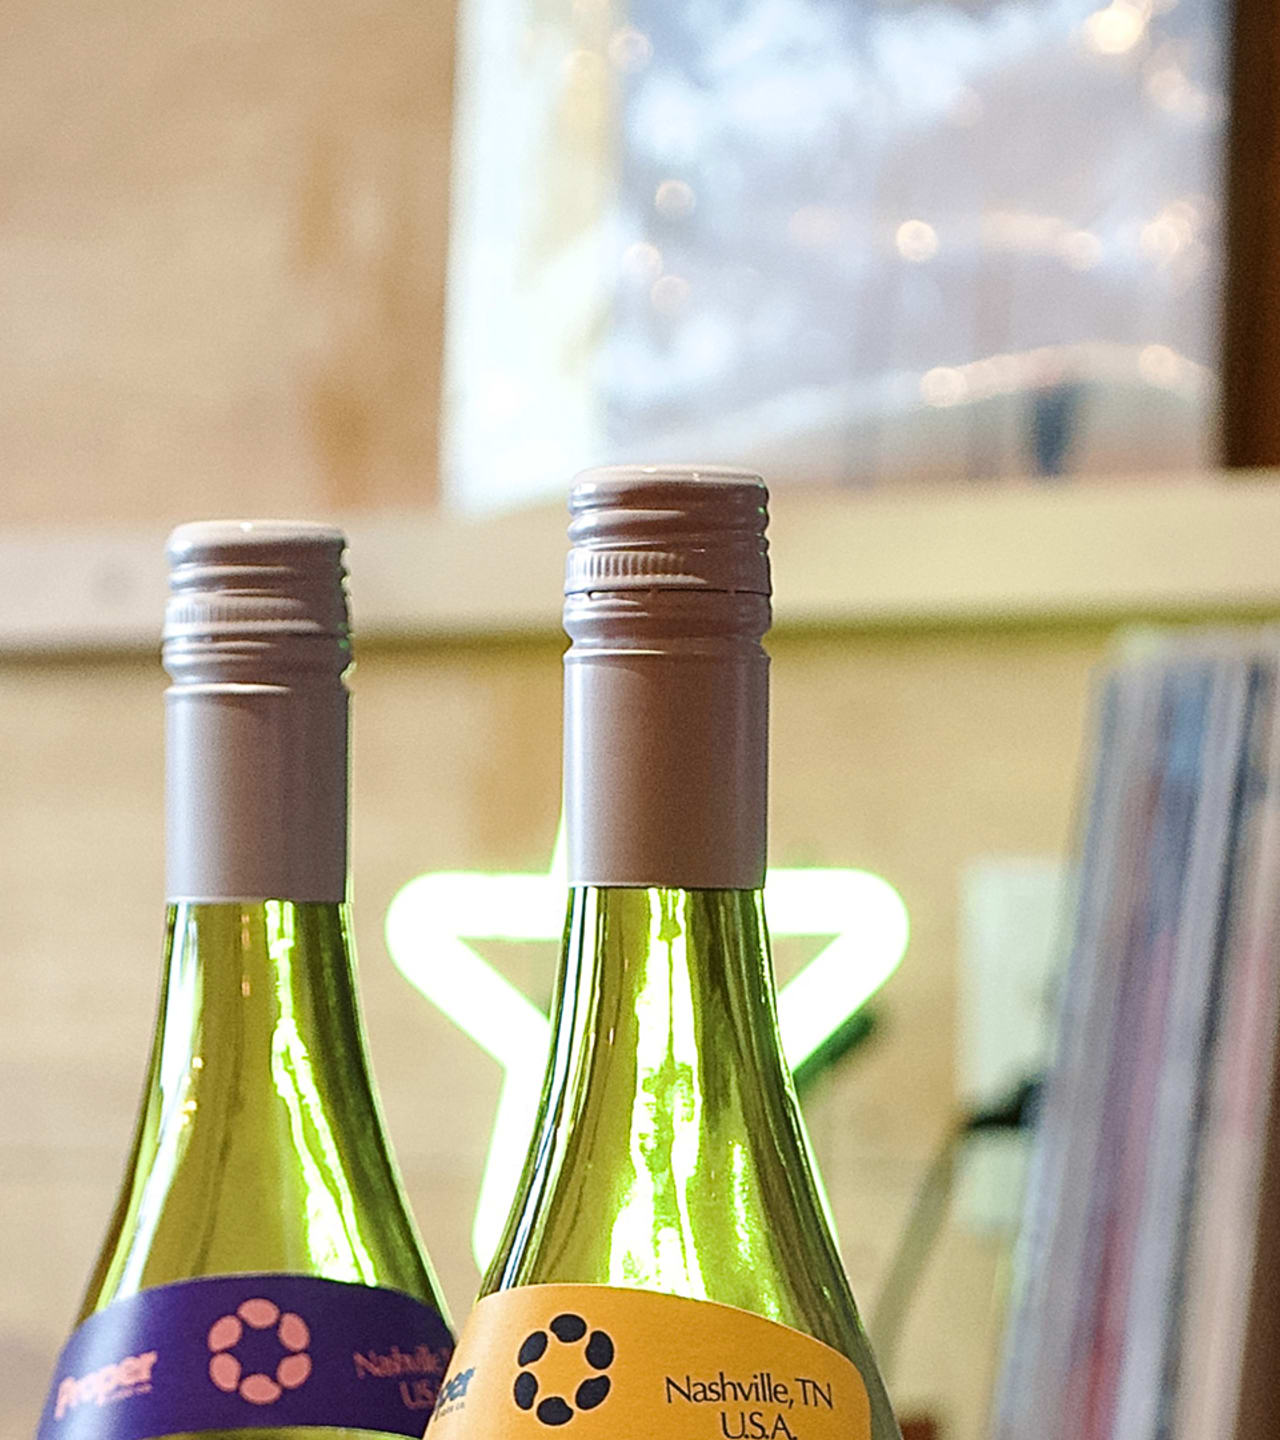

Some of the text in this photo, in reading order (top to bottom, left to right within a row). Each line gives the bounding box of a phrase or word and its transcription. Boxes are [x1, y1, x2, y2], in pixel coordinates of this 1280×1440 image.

[665, 1371, 834, 1410] Nashville, TN
[721, 1411, 798, 1440] U.S.A.
